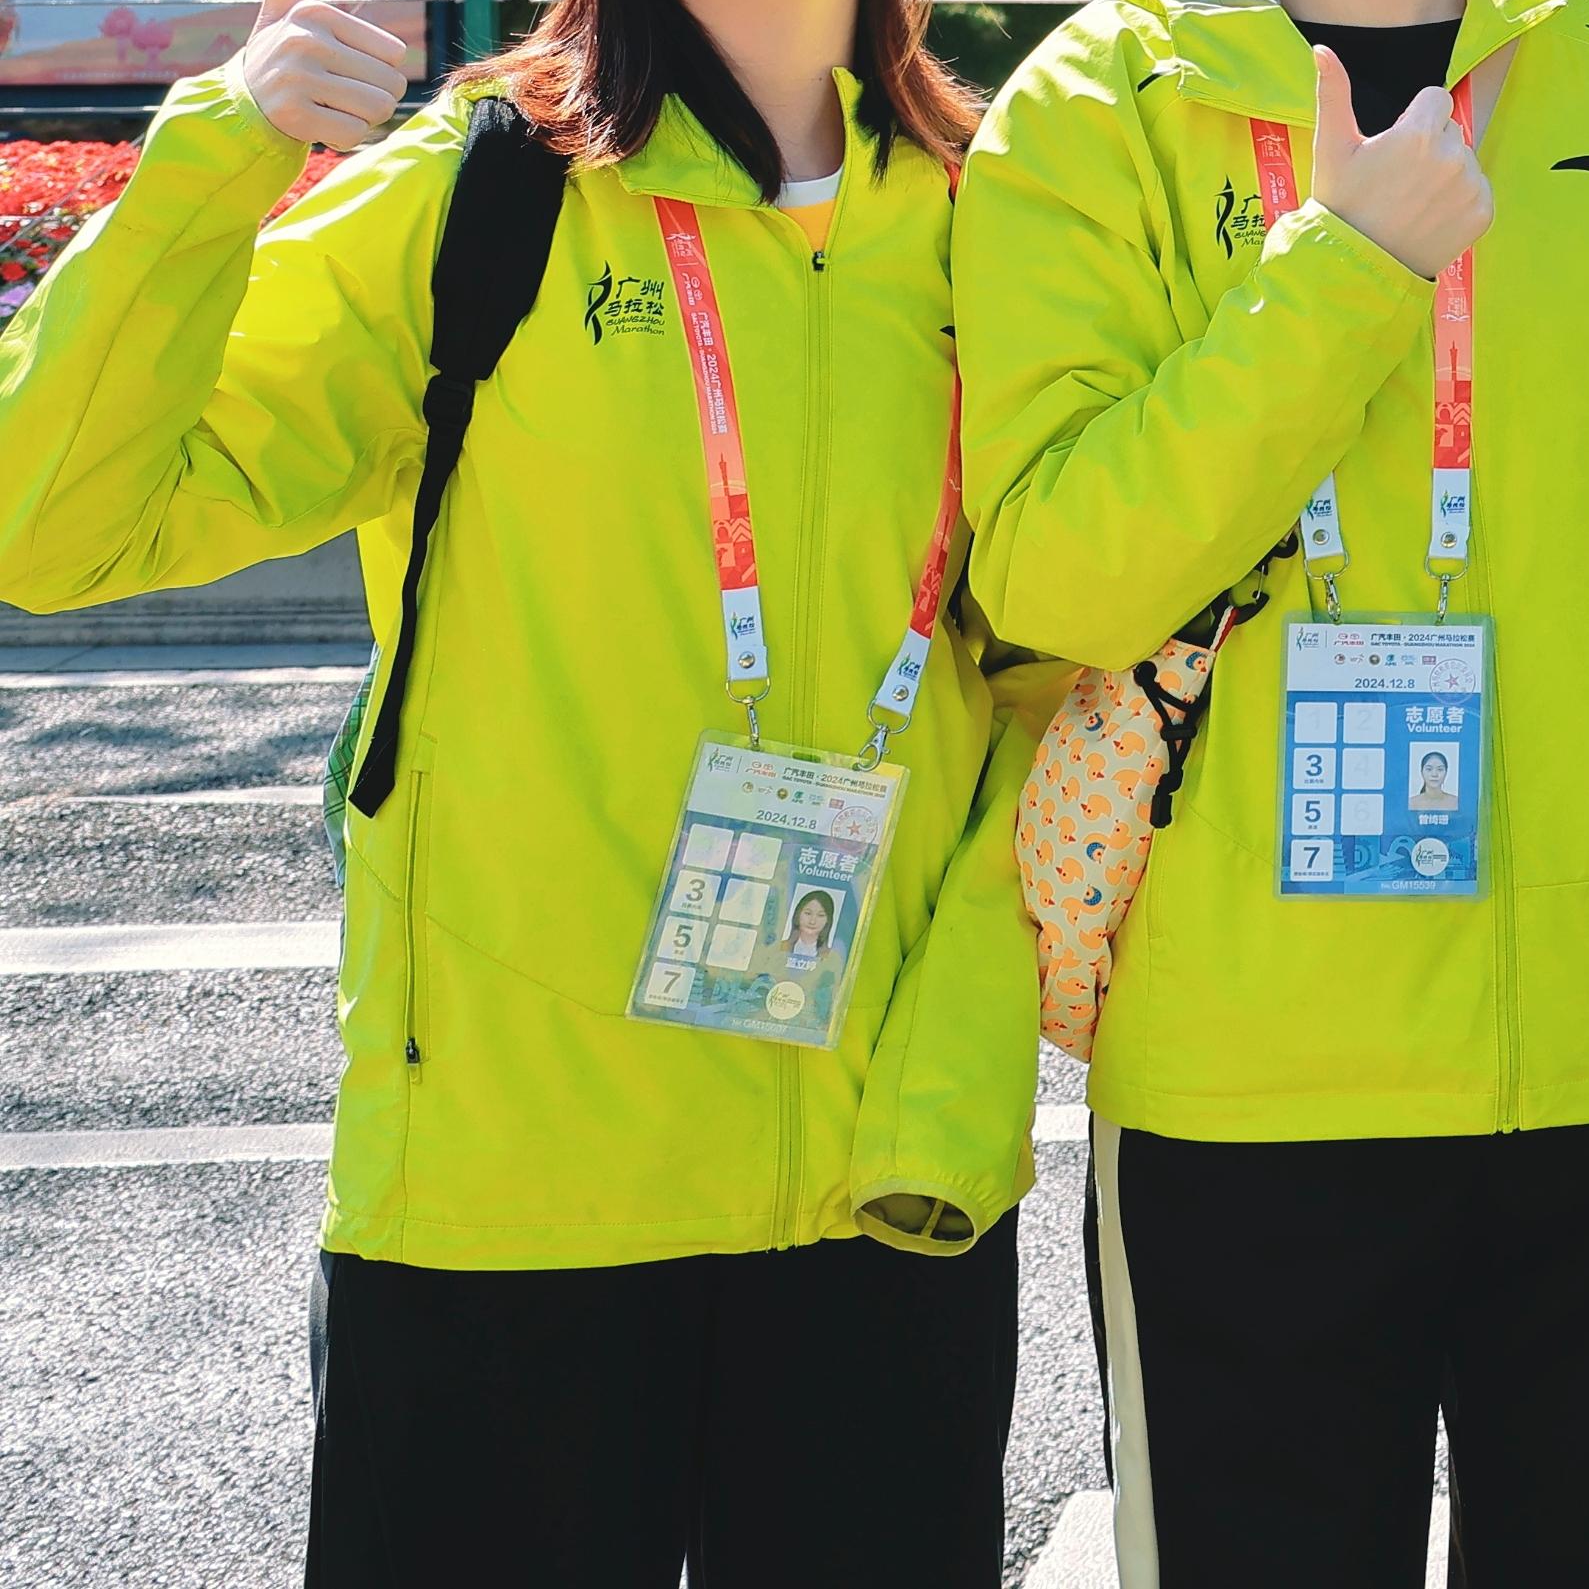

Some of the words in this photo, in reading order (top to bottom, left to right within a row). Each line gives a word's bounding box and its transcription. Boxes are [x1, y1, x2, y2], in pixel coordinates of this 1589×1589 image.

[616, 277, 664, 300] 广州
[604, 298, 664, 316] 马拉松
[606, 315, 665, 326] GUANGZHOU
[611, 325, 664, 336] Marathon
[1354, 678, 1415, 689] 2024.12.8
[1405, 706, 1464, 723] 志愿者
[1407, 722, 1462, 733] Volunteer
[1305, 754, 1323, 777] 3
[756, 808, 817, 830] 2024.12.8
[1304, 800, 1321, 822] 5
[798, 844, 860, 874] 志愿者
[1303, 846, 1320, 869] 7
[797, 862, 853, 885] Volunteer
[684, 876, 707, 904] 3
[672, 922, 694, 950] 5
[659, 969, 682, 996] 7
